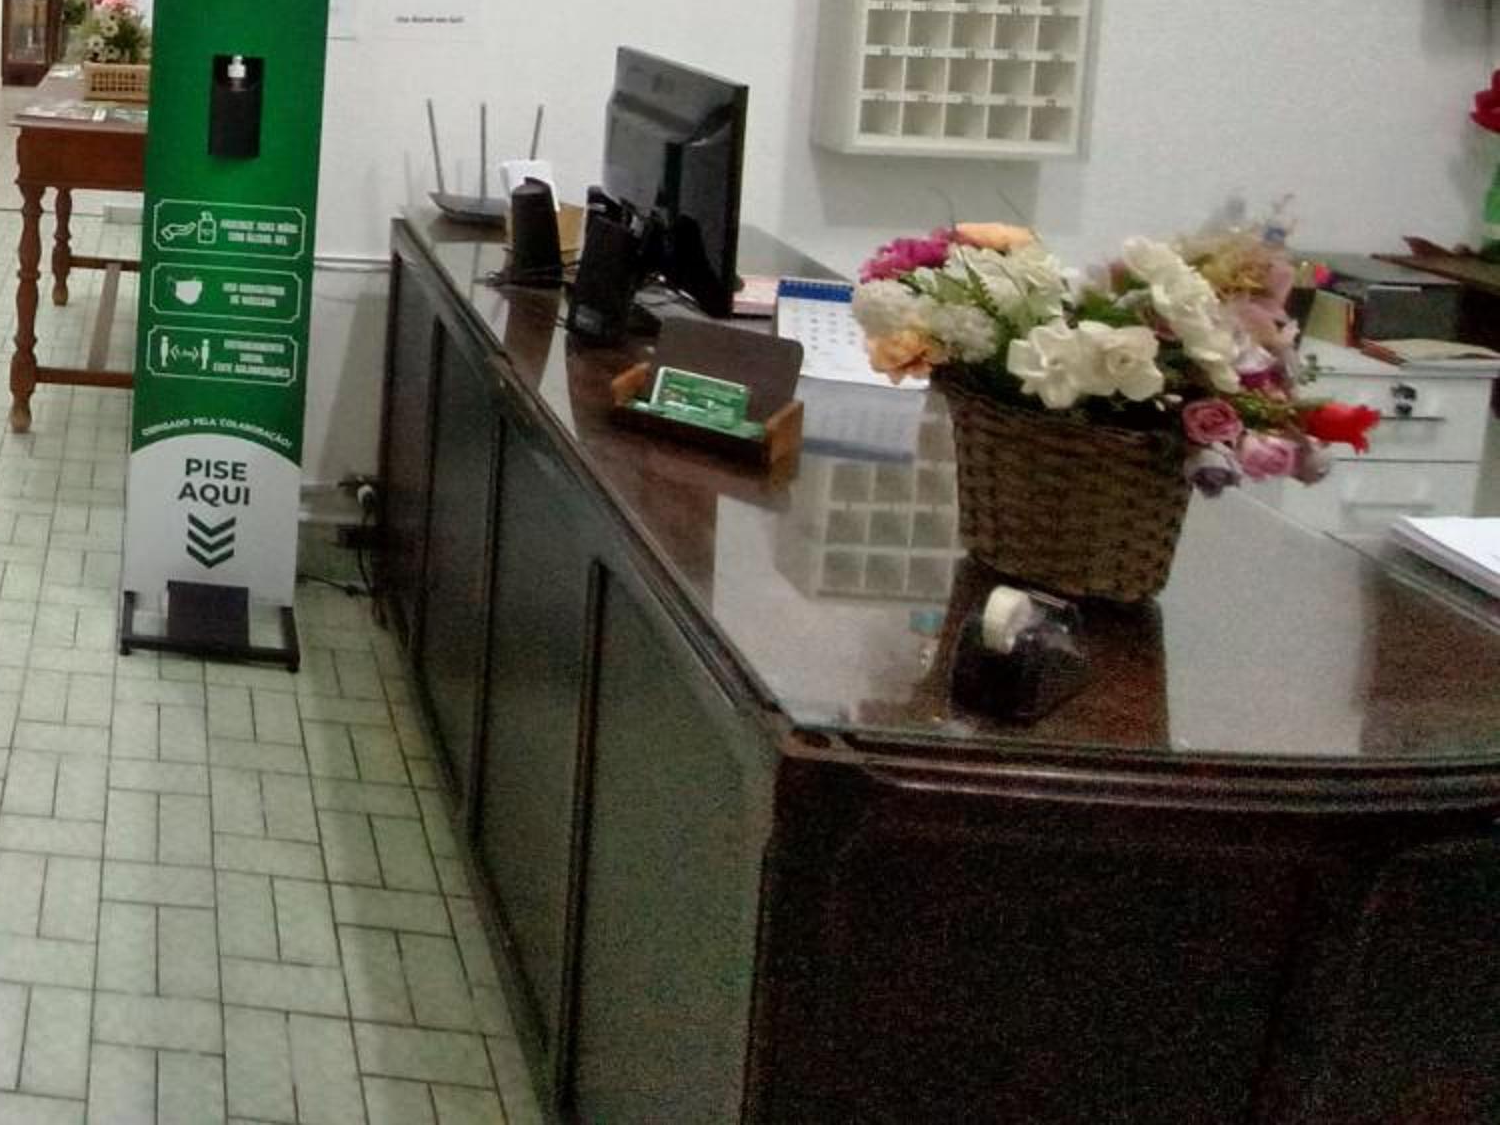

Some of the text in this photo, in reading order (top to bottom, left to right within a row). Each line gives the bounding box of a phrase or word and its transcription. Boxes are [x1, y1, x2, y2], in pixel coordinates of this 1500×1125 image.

[193, 416, 217, 426] PELA
[185, 458, 247, 482] PISE
[178, 482, 250, 507] AQUI
